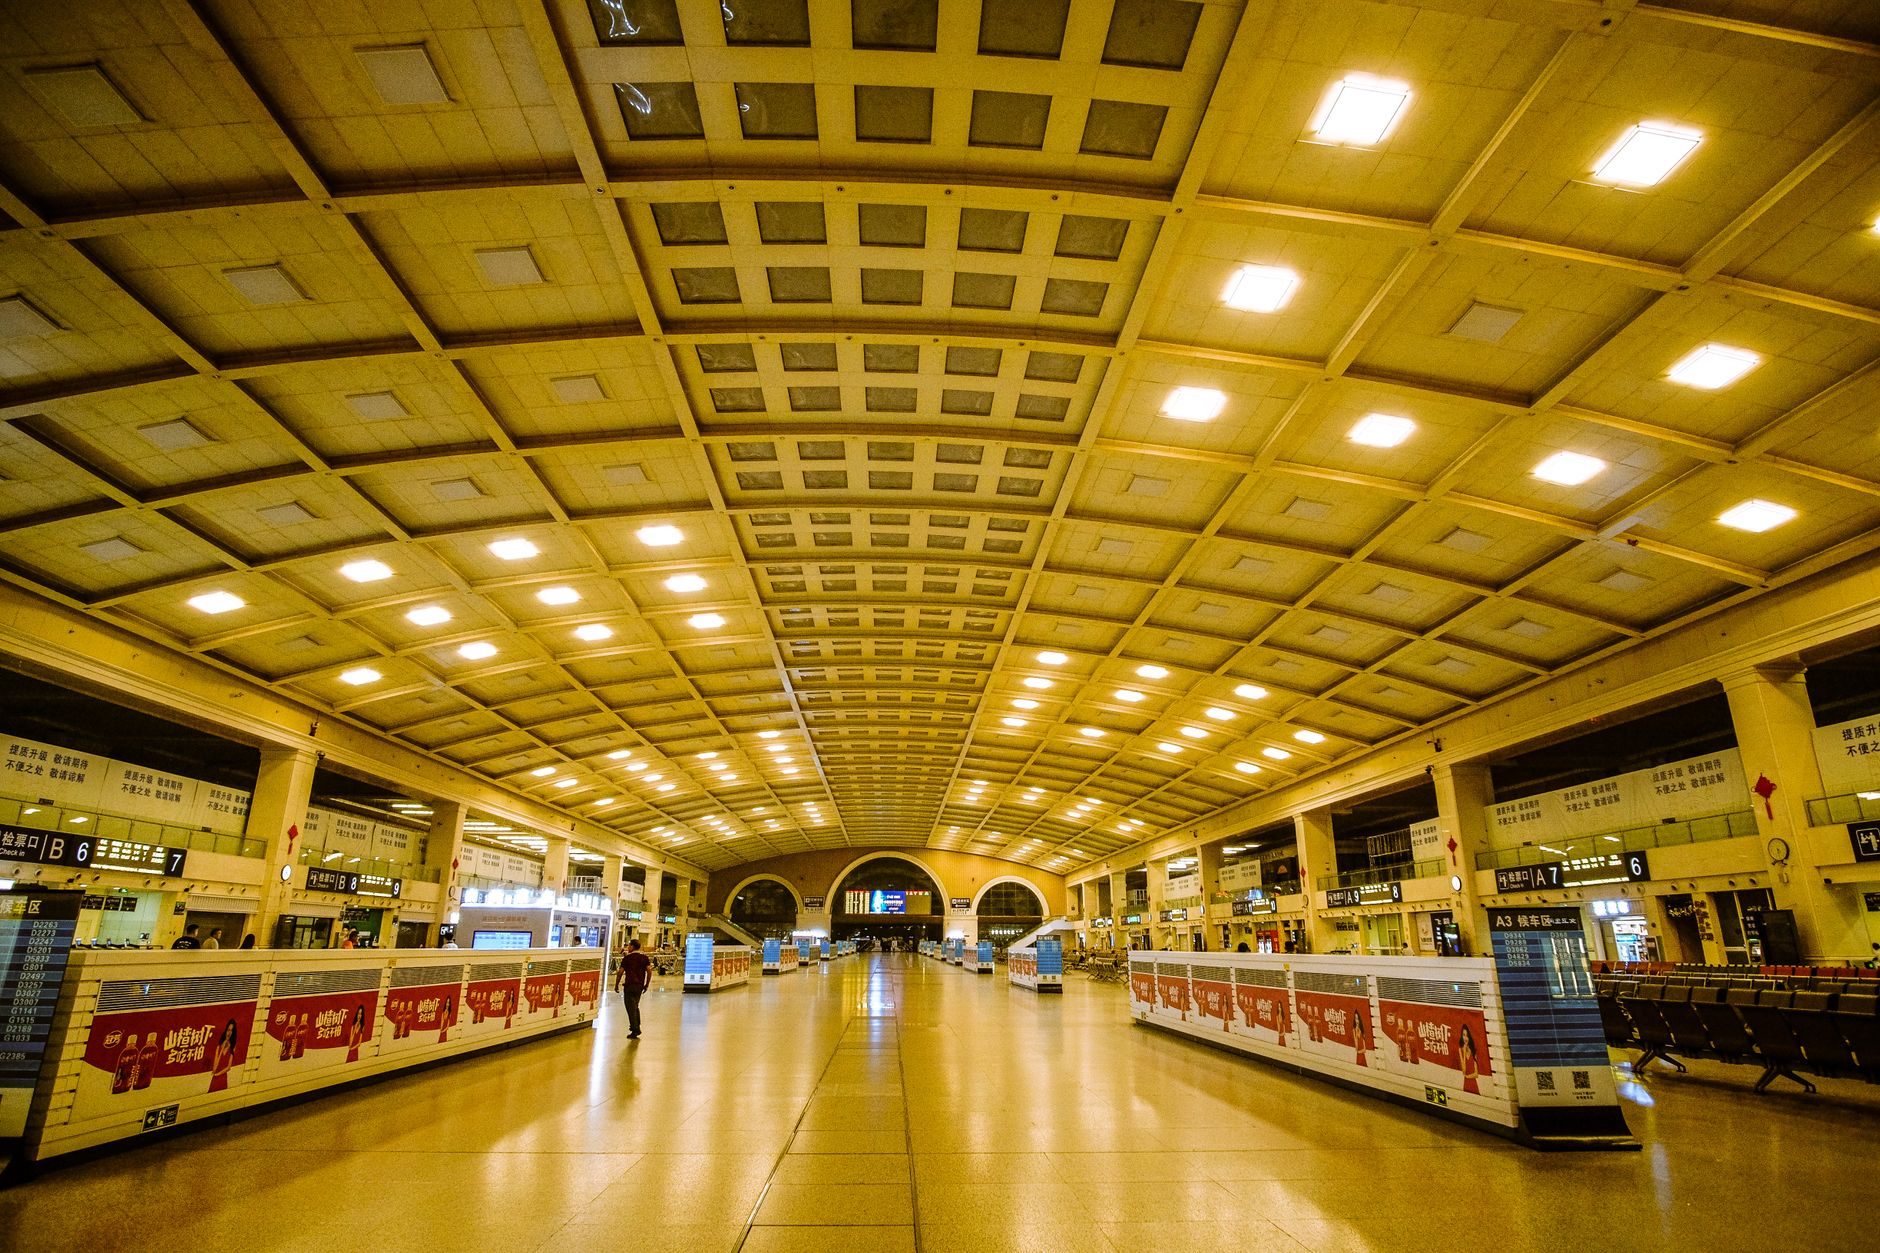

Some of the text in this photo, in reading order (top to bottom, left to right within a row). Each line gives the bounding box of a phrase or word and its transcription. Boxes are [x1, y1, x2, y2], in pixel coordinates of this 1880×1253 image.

[1842, 721, 1880, 741] 提质升
[9, 743, 88, 770] 提质升级 敬请期待
[5, 759, 85, 784] 不便之处 敬请谅解
[124, 769, 153, 785] 提质升级
[1652, 758, 1722, 783] 提质升级 敬请期待
[121, 783, 151, 797] 不便之处
[1655, 772, 1725, 796] 不便之处 敬请谅解
[1563, 787, 1588, 801] 提质升级
[1565, 801, 1591, 814] 不便之处
[2, 831, 39, 848] 检票口
[0, 847, 18, 856] Check
[49, 838, 65, 859] B
[77, 842, 89, 862] 6
[171, 854, 182, 872] 7
[1630, 857, 1642, 876] 6
[338, 875, 346, 889] B
[1508, 871, 1529, 883] 检票口
[1536, 869, 1546, 886] A
[1548, 867, 1558, 884] 7
[351, 877, 357, 890] 8
[393, 882, 400, 895] 9
[1347, 891, 1354, 903] A
[1354, 890, 1359, 902] 9
[1392, 885, 1399, 898] 8
[1496, 915, 1512, 927] A3
[1517, 914, 1552, 927] 候车区
[22, 963, 44, 971] G801
[20, 972, 45, 980] D2497
[18, 981, 43, 989] D3257
[13, 998, 39, 1006] D3007
[11, 1007, 37, 1015] G1141
[8, 1016, 35, 1024] G1515
[163, 1024, 216, 1051] 山楂树下
[0, 1052, 26, 1060] G2385
[166, 1045, 205, 1065] 多吃不怕
